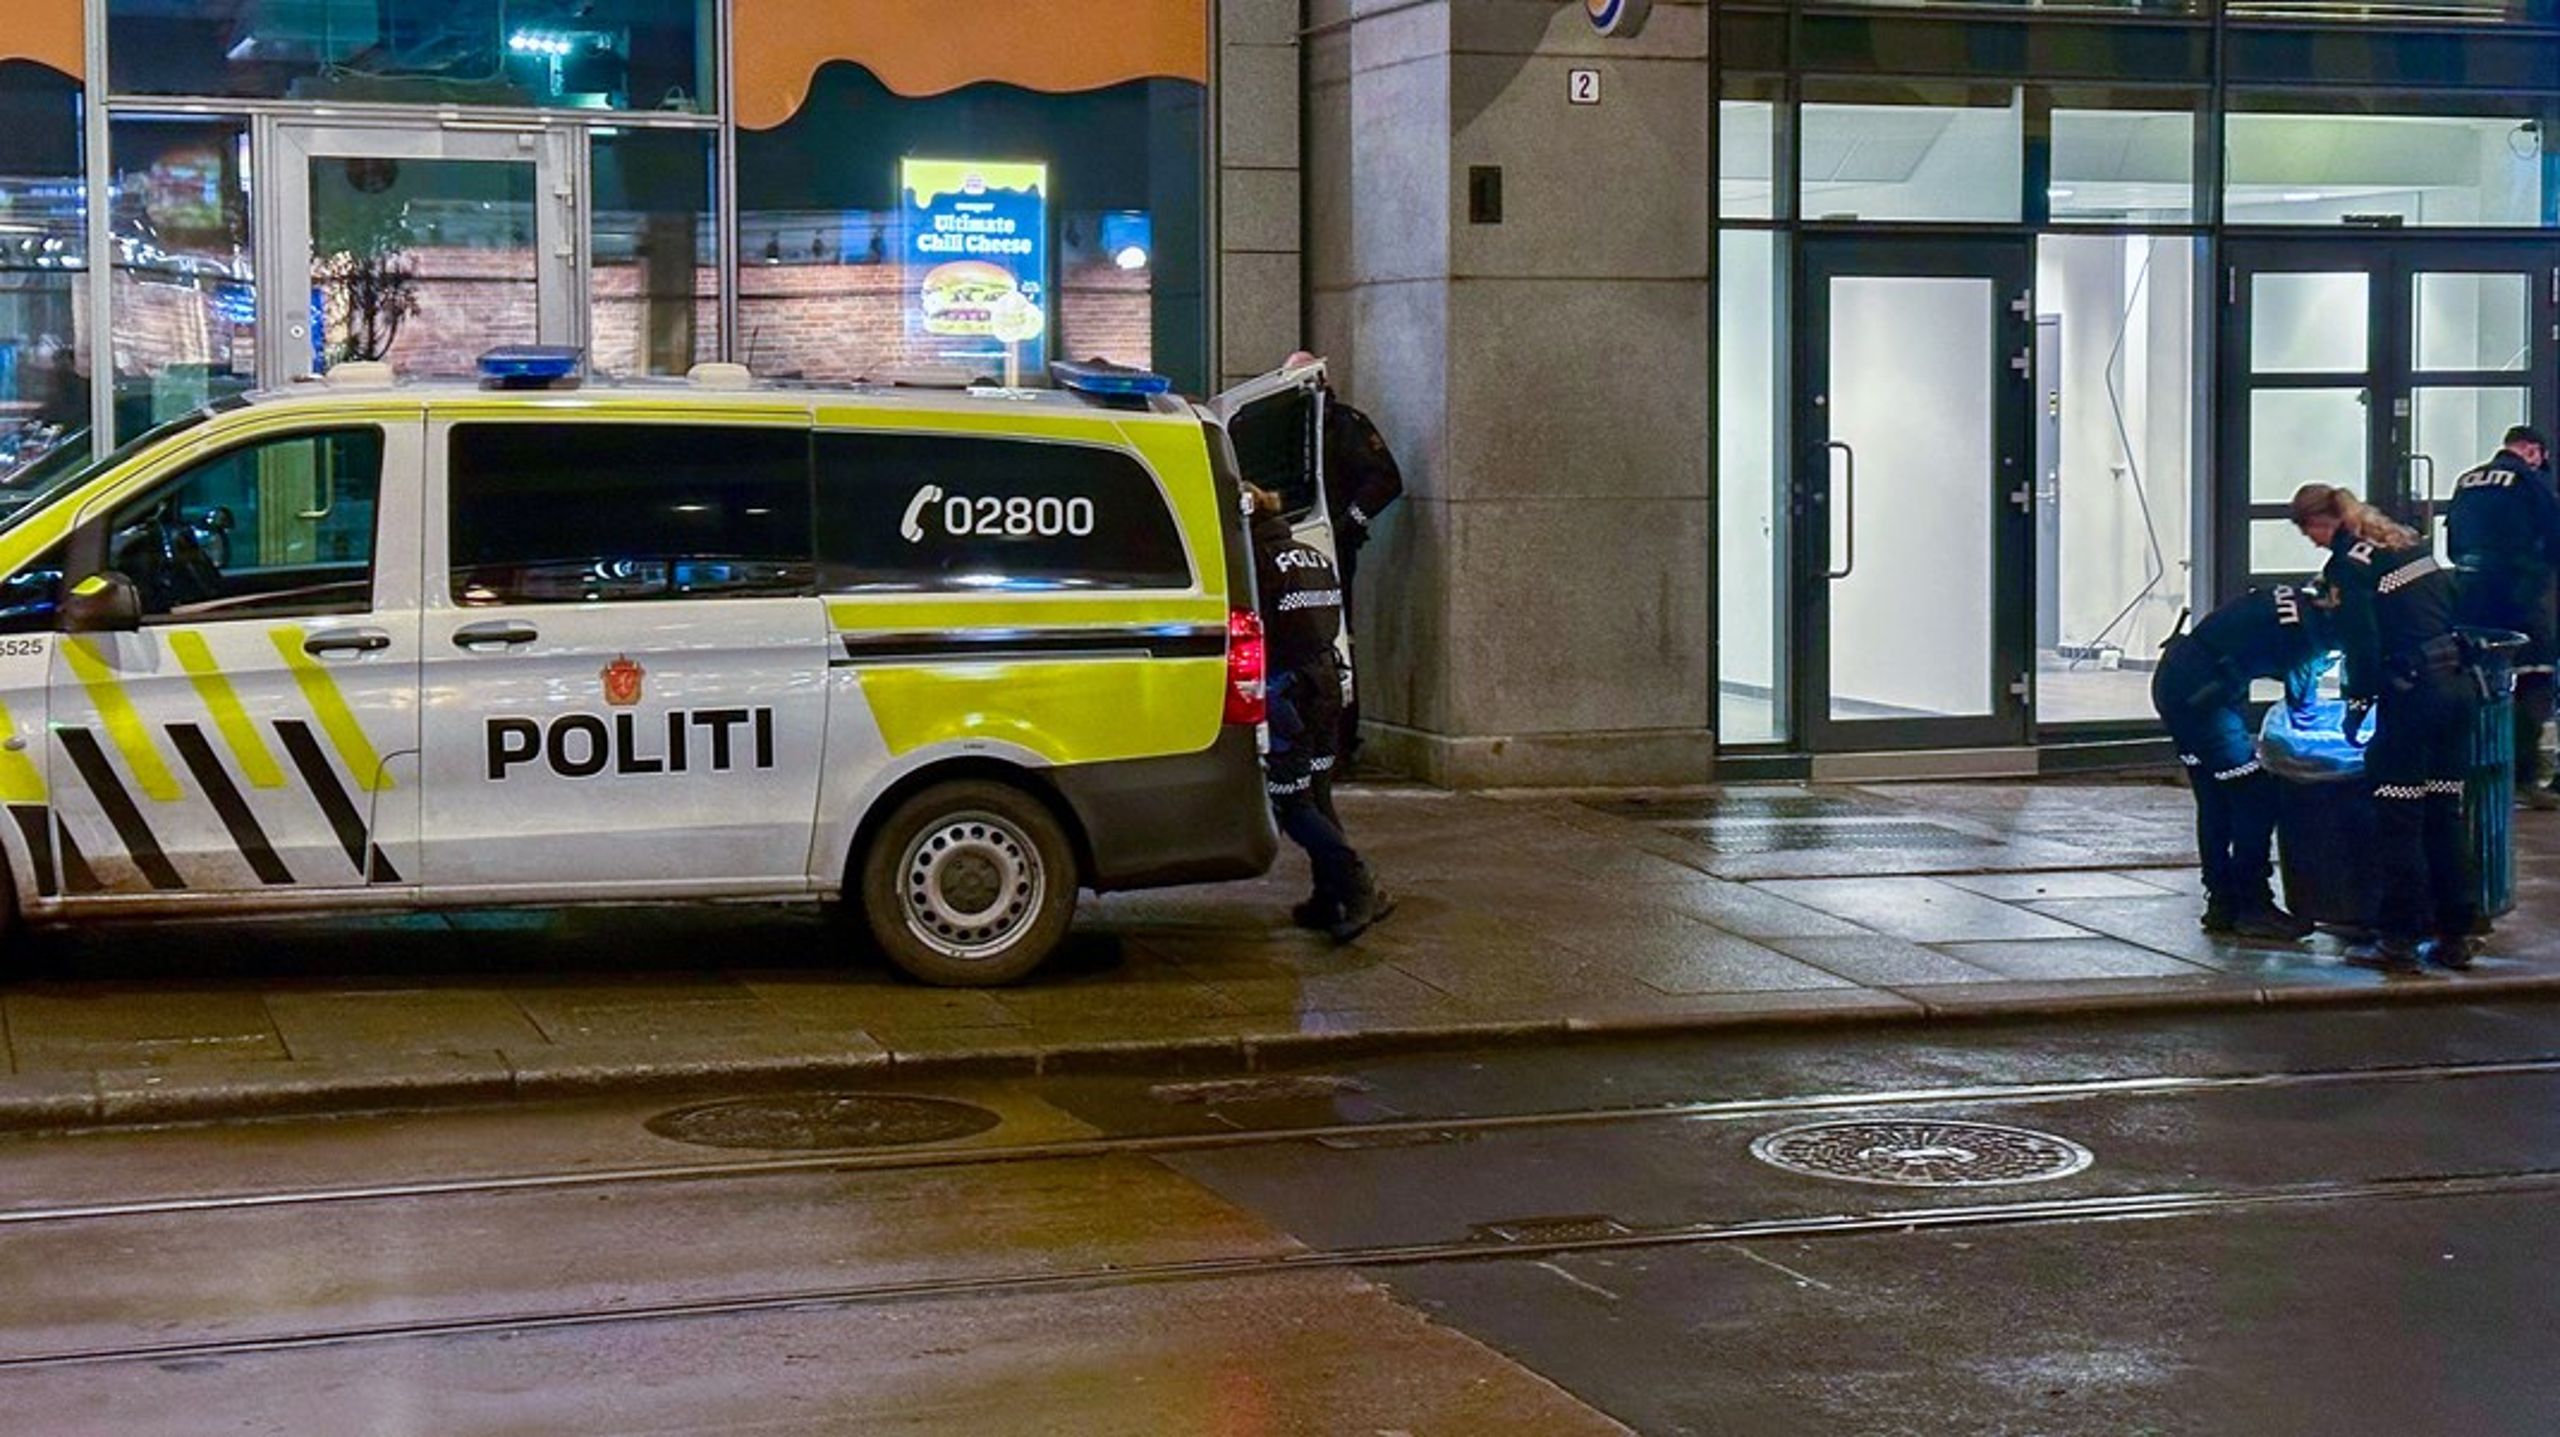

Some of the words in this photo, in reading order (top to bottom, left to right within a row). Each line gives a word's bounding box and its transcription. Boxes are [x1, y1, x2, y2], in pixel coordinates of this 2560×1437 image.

[1577, 73, 1592, 99] 2
[934, 213, 1016, 235] Ultimate
[965, 234, 1033, 255] Cheese
[2458, 469, 2516, 488] OLITI
[944, 496, 1095, 536] 02800
[1274, 548, 1329, 573] POLIT
[486, 707, 774, 780] POLITI
